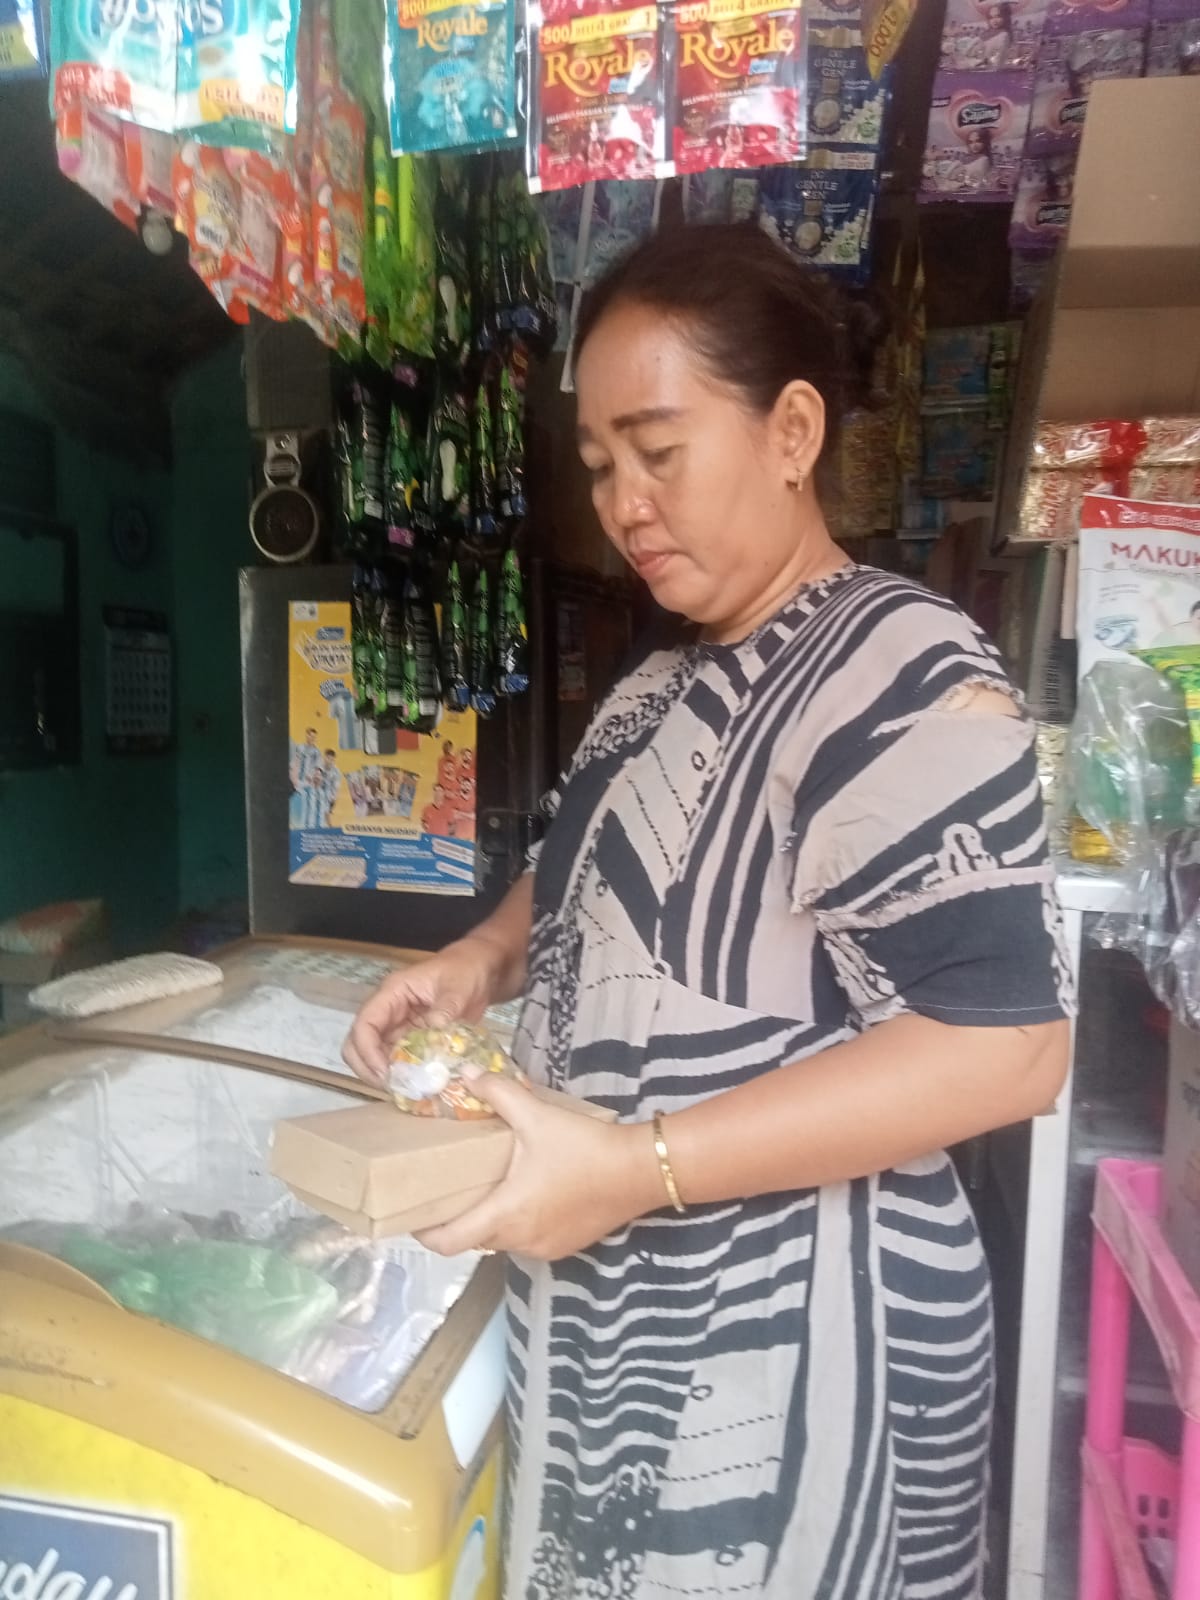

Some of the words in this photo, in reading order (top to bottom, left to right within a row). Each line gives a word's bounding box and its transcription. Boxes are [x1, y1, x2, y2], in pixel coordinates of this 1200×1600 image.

[416, 8, 488, 52] Royale
[680, 19, 796, 79] Royale
[543, 39, 655, 97] Royale
[813, 57, 857, 69] GENTLE
[794, 180, 839, 191] GENTLE
